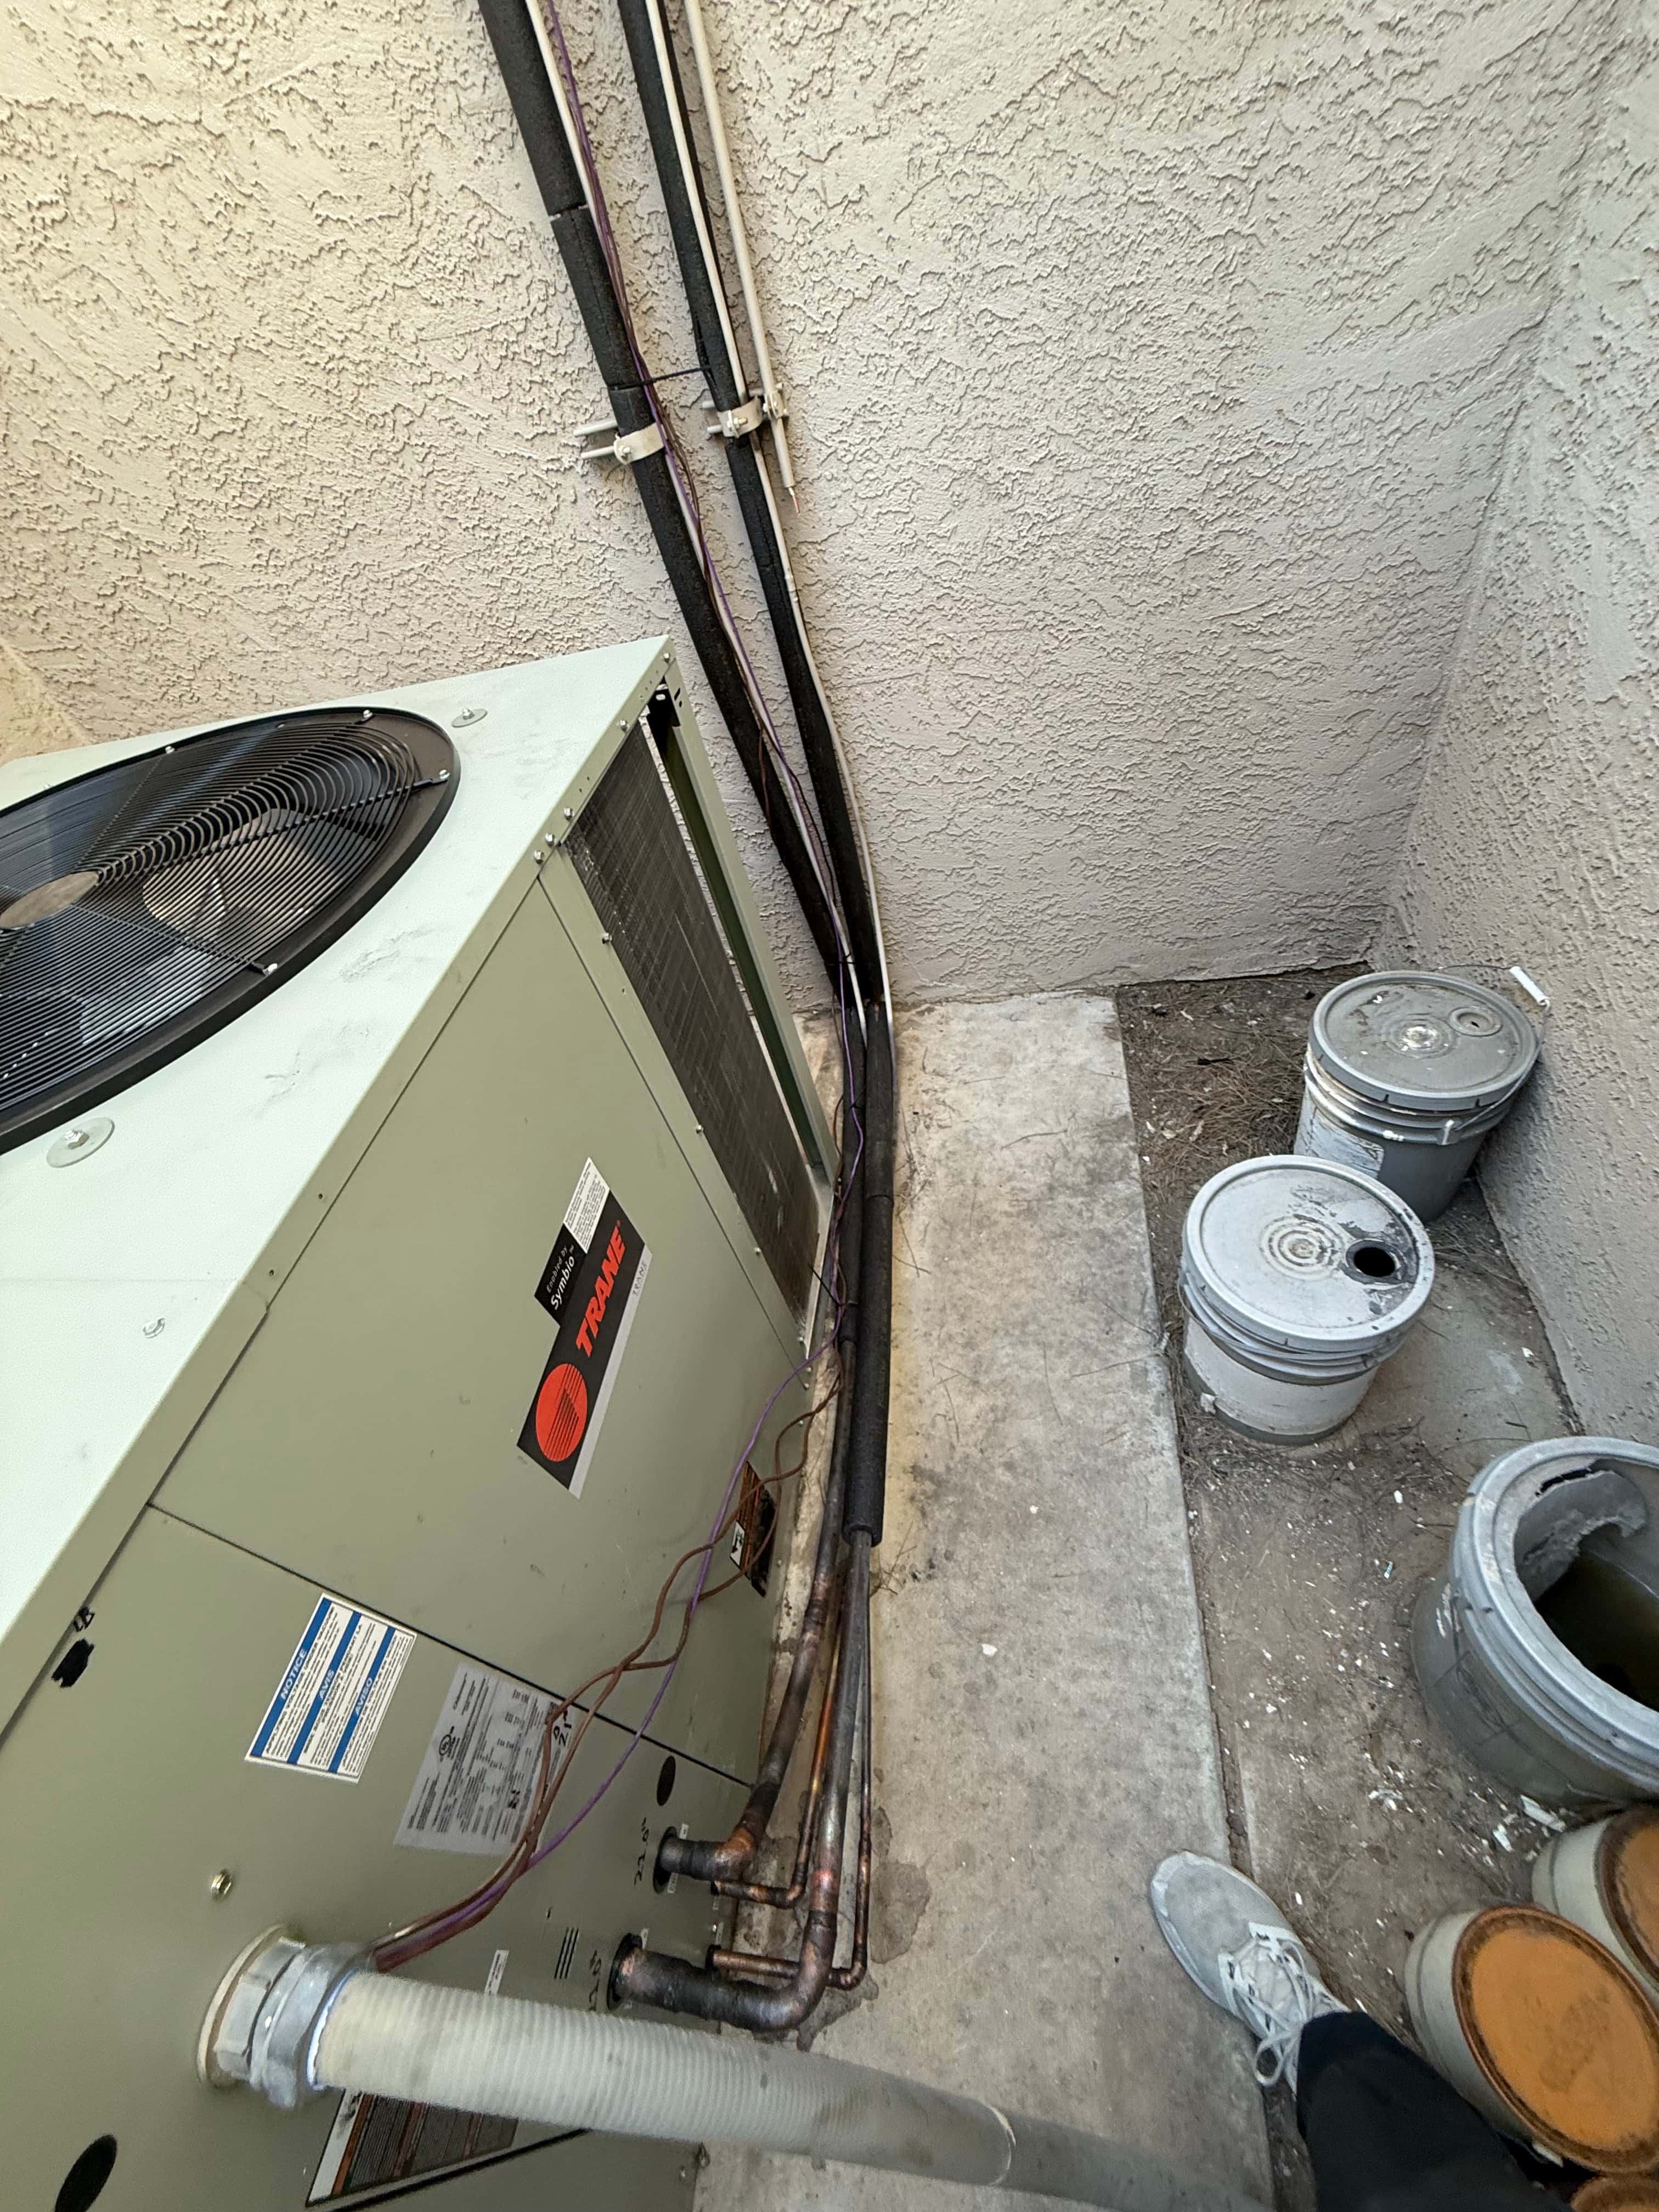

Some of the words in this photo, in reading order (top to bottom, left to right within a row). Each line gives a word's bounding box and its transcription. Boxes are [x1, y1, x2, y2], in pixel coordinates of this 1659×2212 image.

[546, 1256, 562, 1293] Enabled
[560, 1244, 568, 1257] by
[575, 1226, 625, 1357] TRANE
[279, 1648, 308, 1699] NOTICE
[317, 1669, 334, 1700] AVIS
[353, 1677, 374, 1715] AVISO
